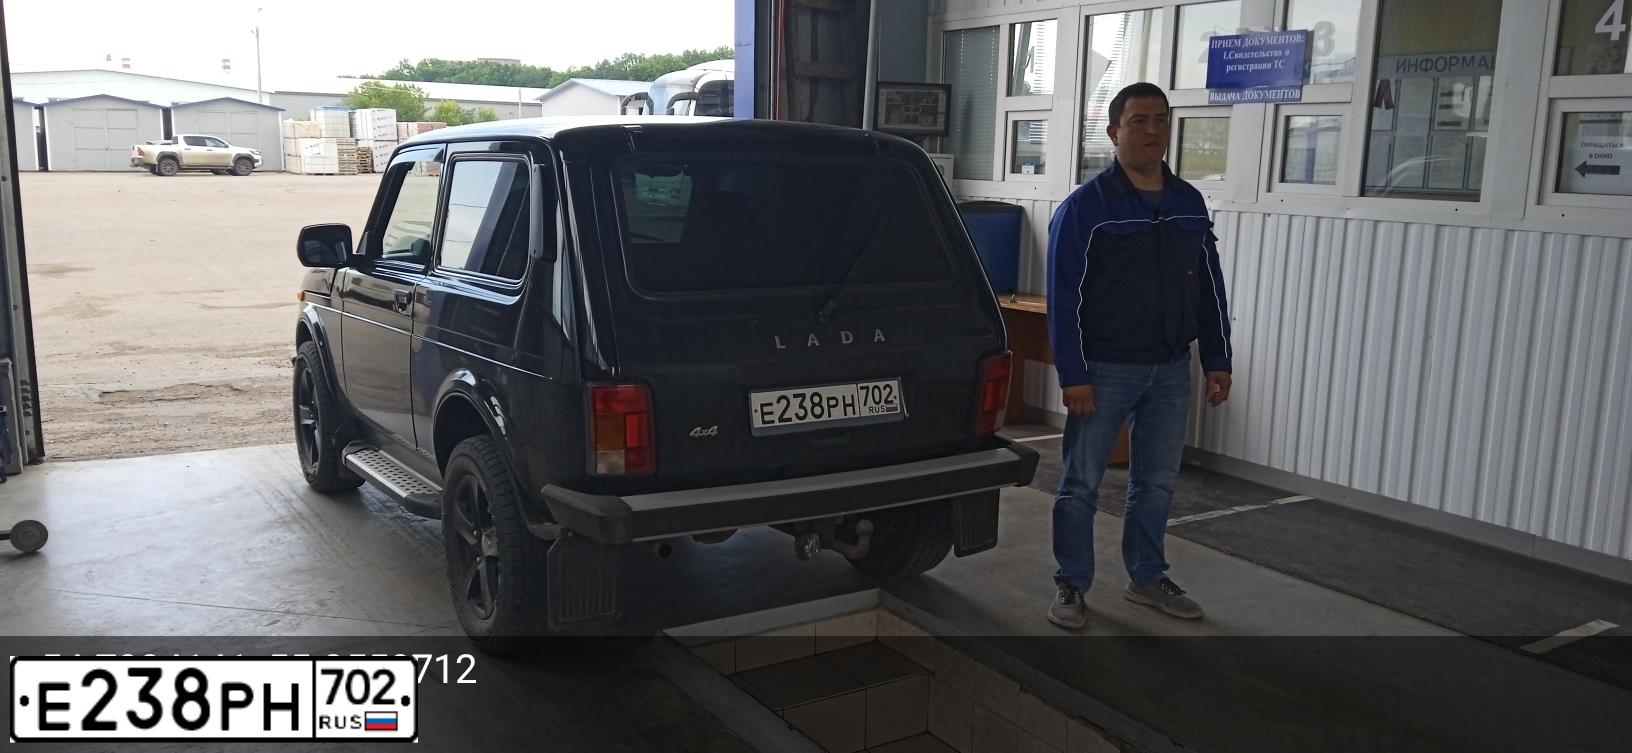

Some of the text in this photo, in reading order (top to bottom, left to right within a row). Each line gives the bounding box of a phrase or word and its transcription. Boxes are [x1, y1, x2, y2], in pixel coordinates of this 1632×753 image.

[1594, 0, 1627, 41] 4
[1211, 33, 1304, 49] ПРИЕМ ДОКУМЕНТОВ:
[1226, 60, 1285, 73] регистрации ТС
[1210, 88, 1301, 102] ВЫДАЧА ДОКУМЕНТОВ
[774, 329, 886, 349] LADA
[859, 383, 894, 407] 702
[868, 404, 886, 414] RUS
